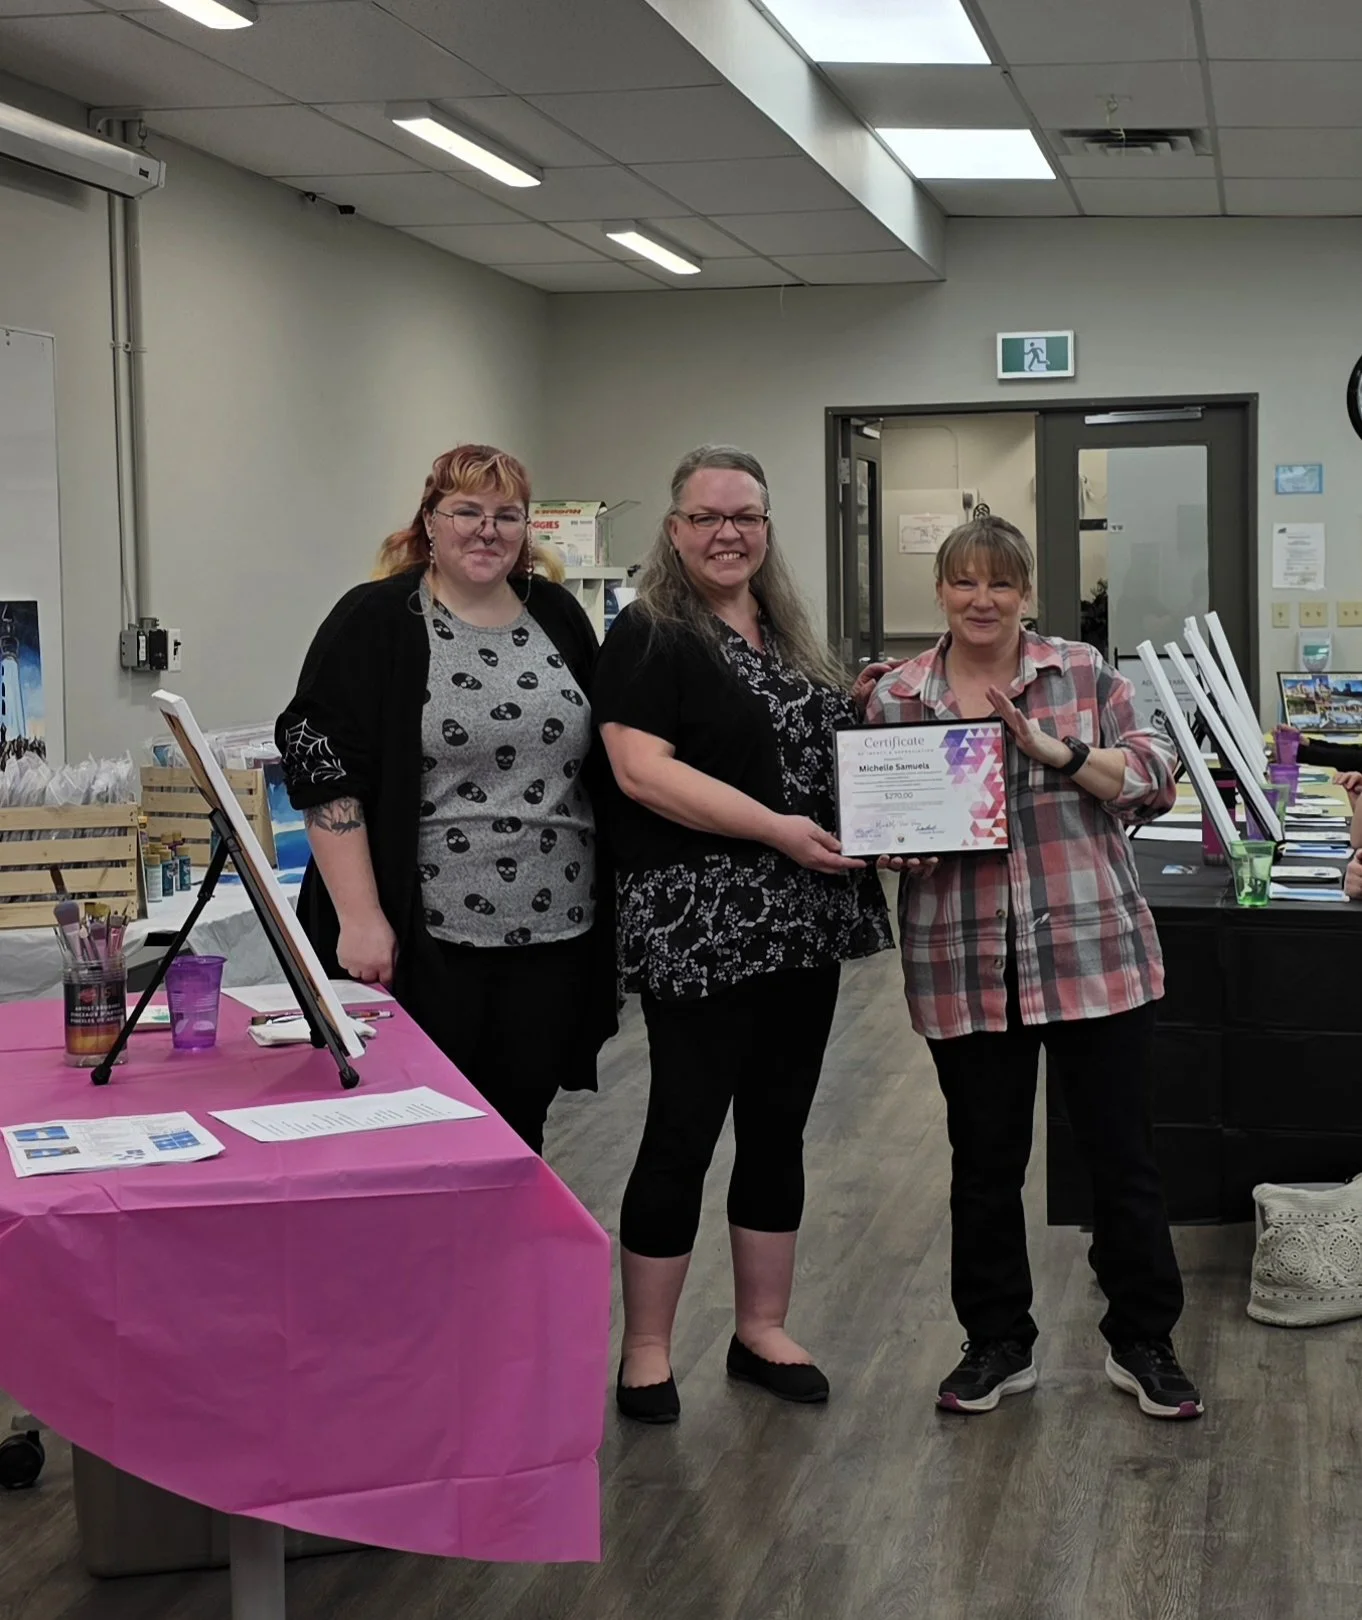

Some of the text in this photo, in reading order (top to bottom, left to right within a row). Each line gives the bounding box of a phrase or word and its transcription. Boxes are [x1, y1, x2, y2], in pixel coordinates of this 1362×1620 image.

[864, 736, 925, 750] Certificate
[859, 762, 930, 772] Michelle Samuels
[885, 792, 914, 800] $270.00
